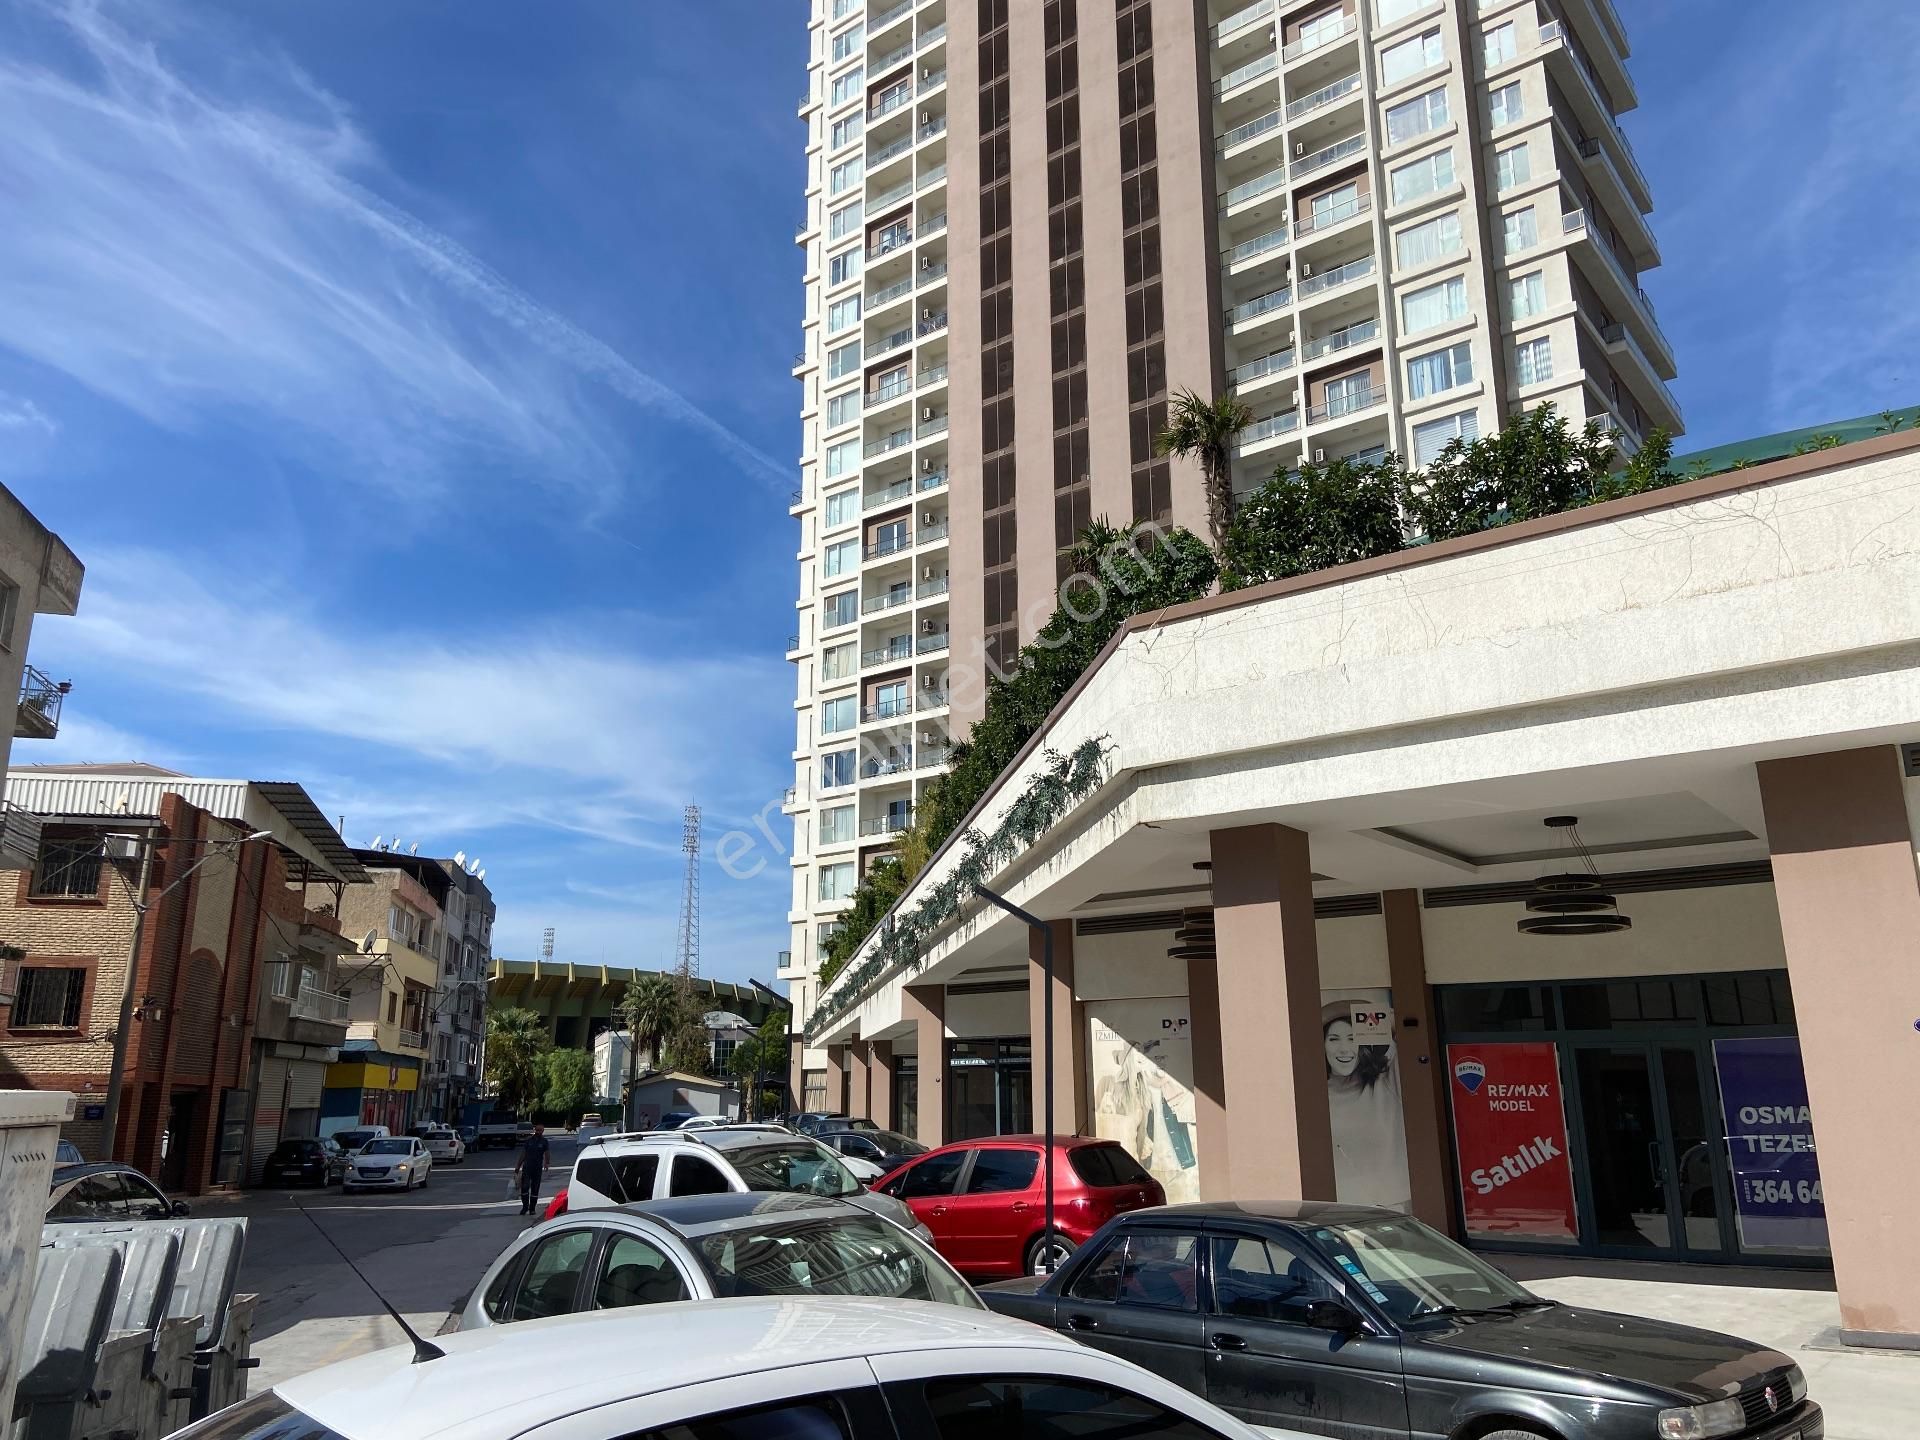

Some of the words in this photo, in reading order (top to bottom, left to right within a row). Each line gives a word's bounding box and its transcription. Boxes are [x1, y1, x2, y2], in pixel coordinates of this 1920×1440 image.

[1487, 1084, 1549, 1097] RE/MAX
[1489, 1100, 1535, 1112] MODEL
[1470, 1136, 1562, 1195] Satılık
[1751, 1180, 1794, 1204] 364
[1796, 1180, 1824, 1204] 64
